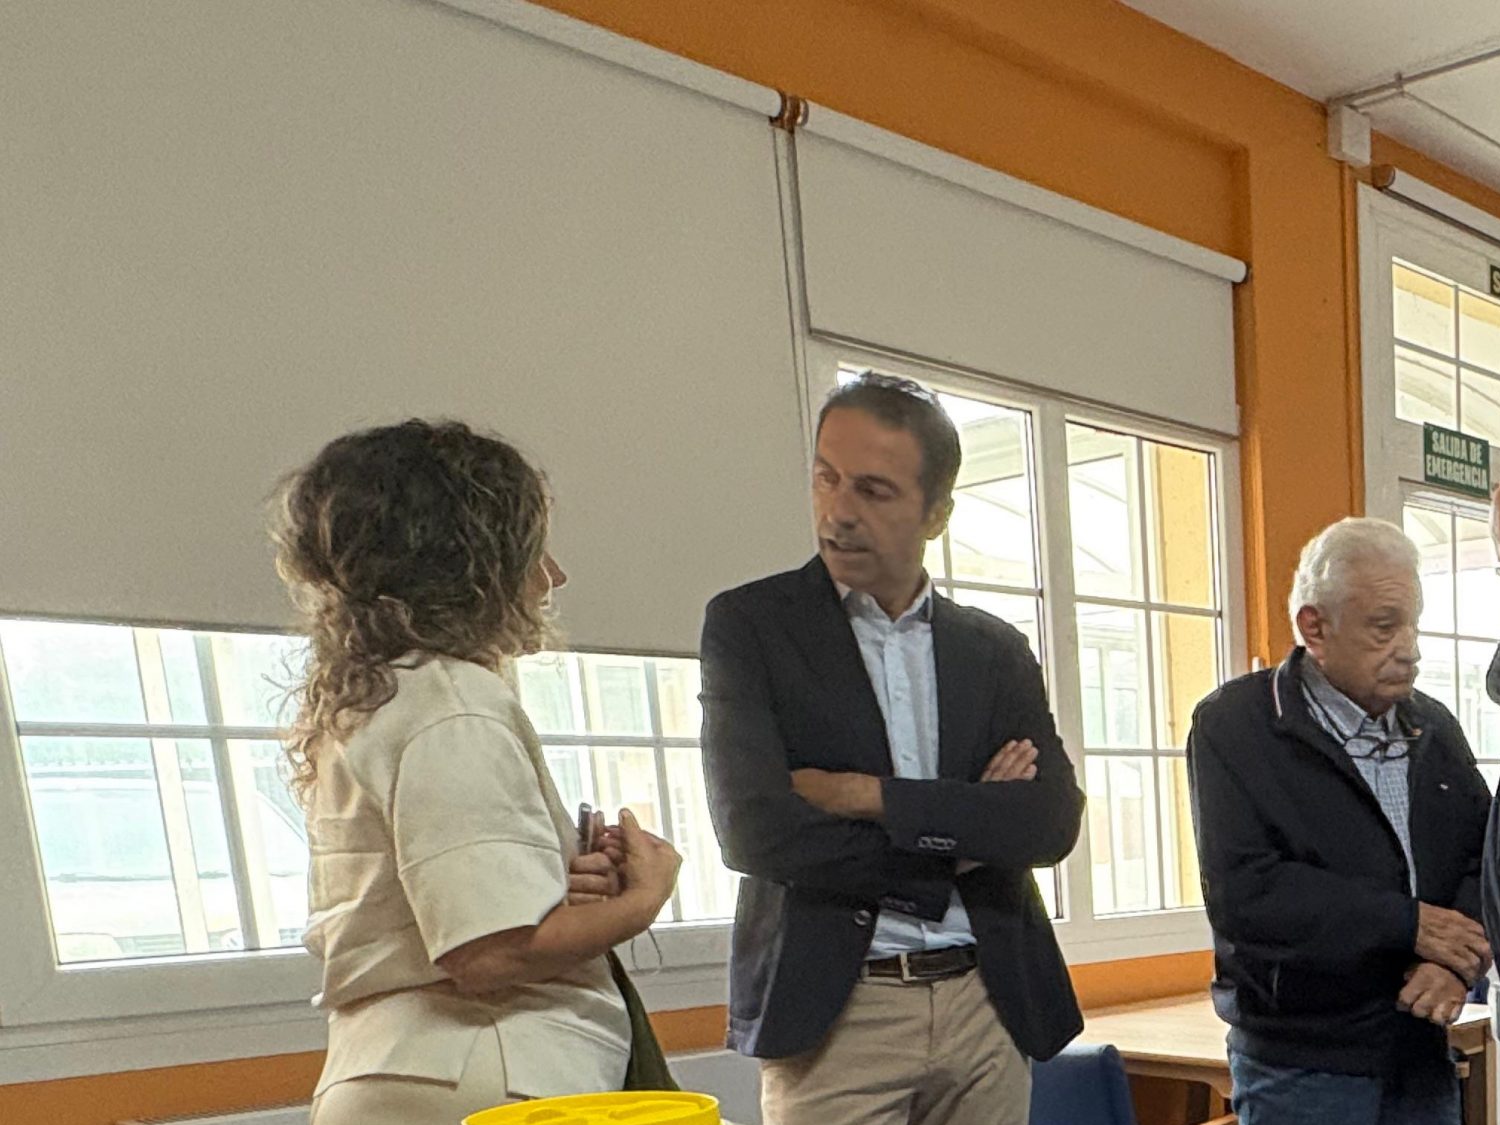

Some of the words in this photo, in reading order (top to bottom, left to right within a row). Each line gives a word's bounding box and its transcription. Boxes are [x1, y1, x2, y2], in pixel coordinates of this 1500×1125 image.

[1432, 430, 1469, 462] SALIDA
[1470, 441, 1483, 466] DE
[1425, 453, 1488, 490] EMERGENCIA
